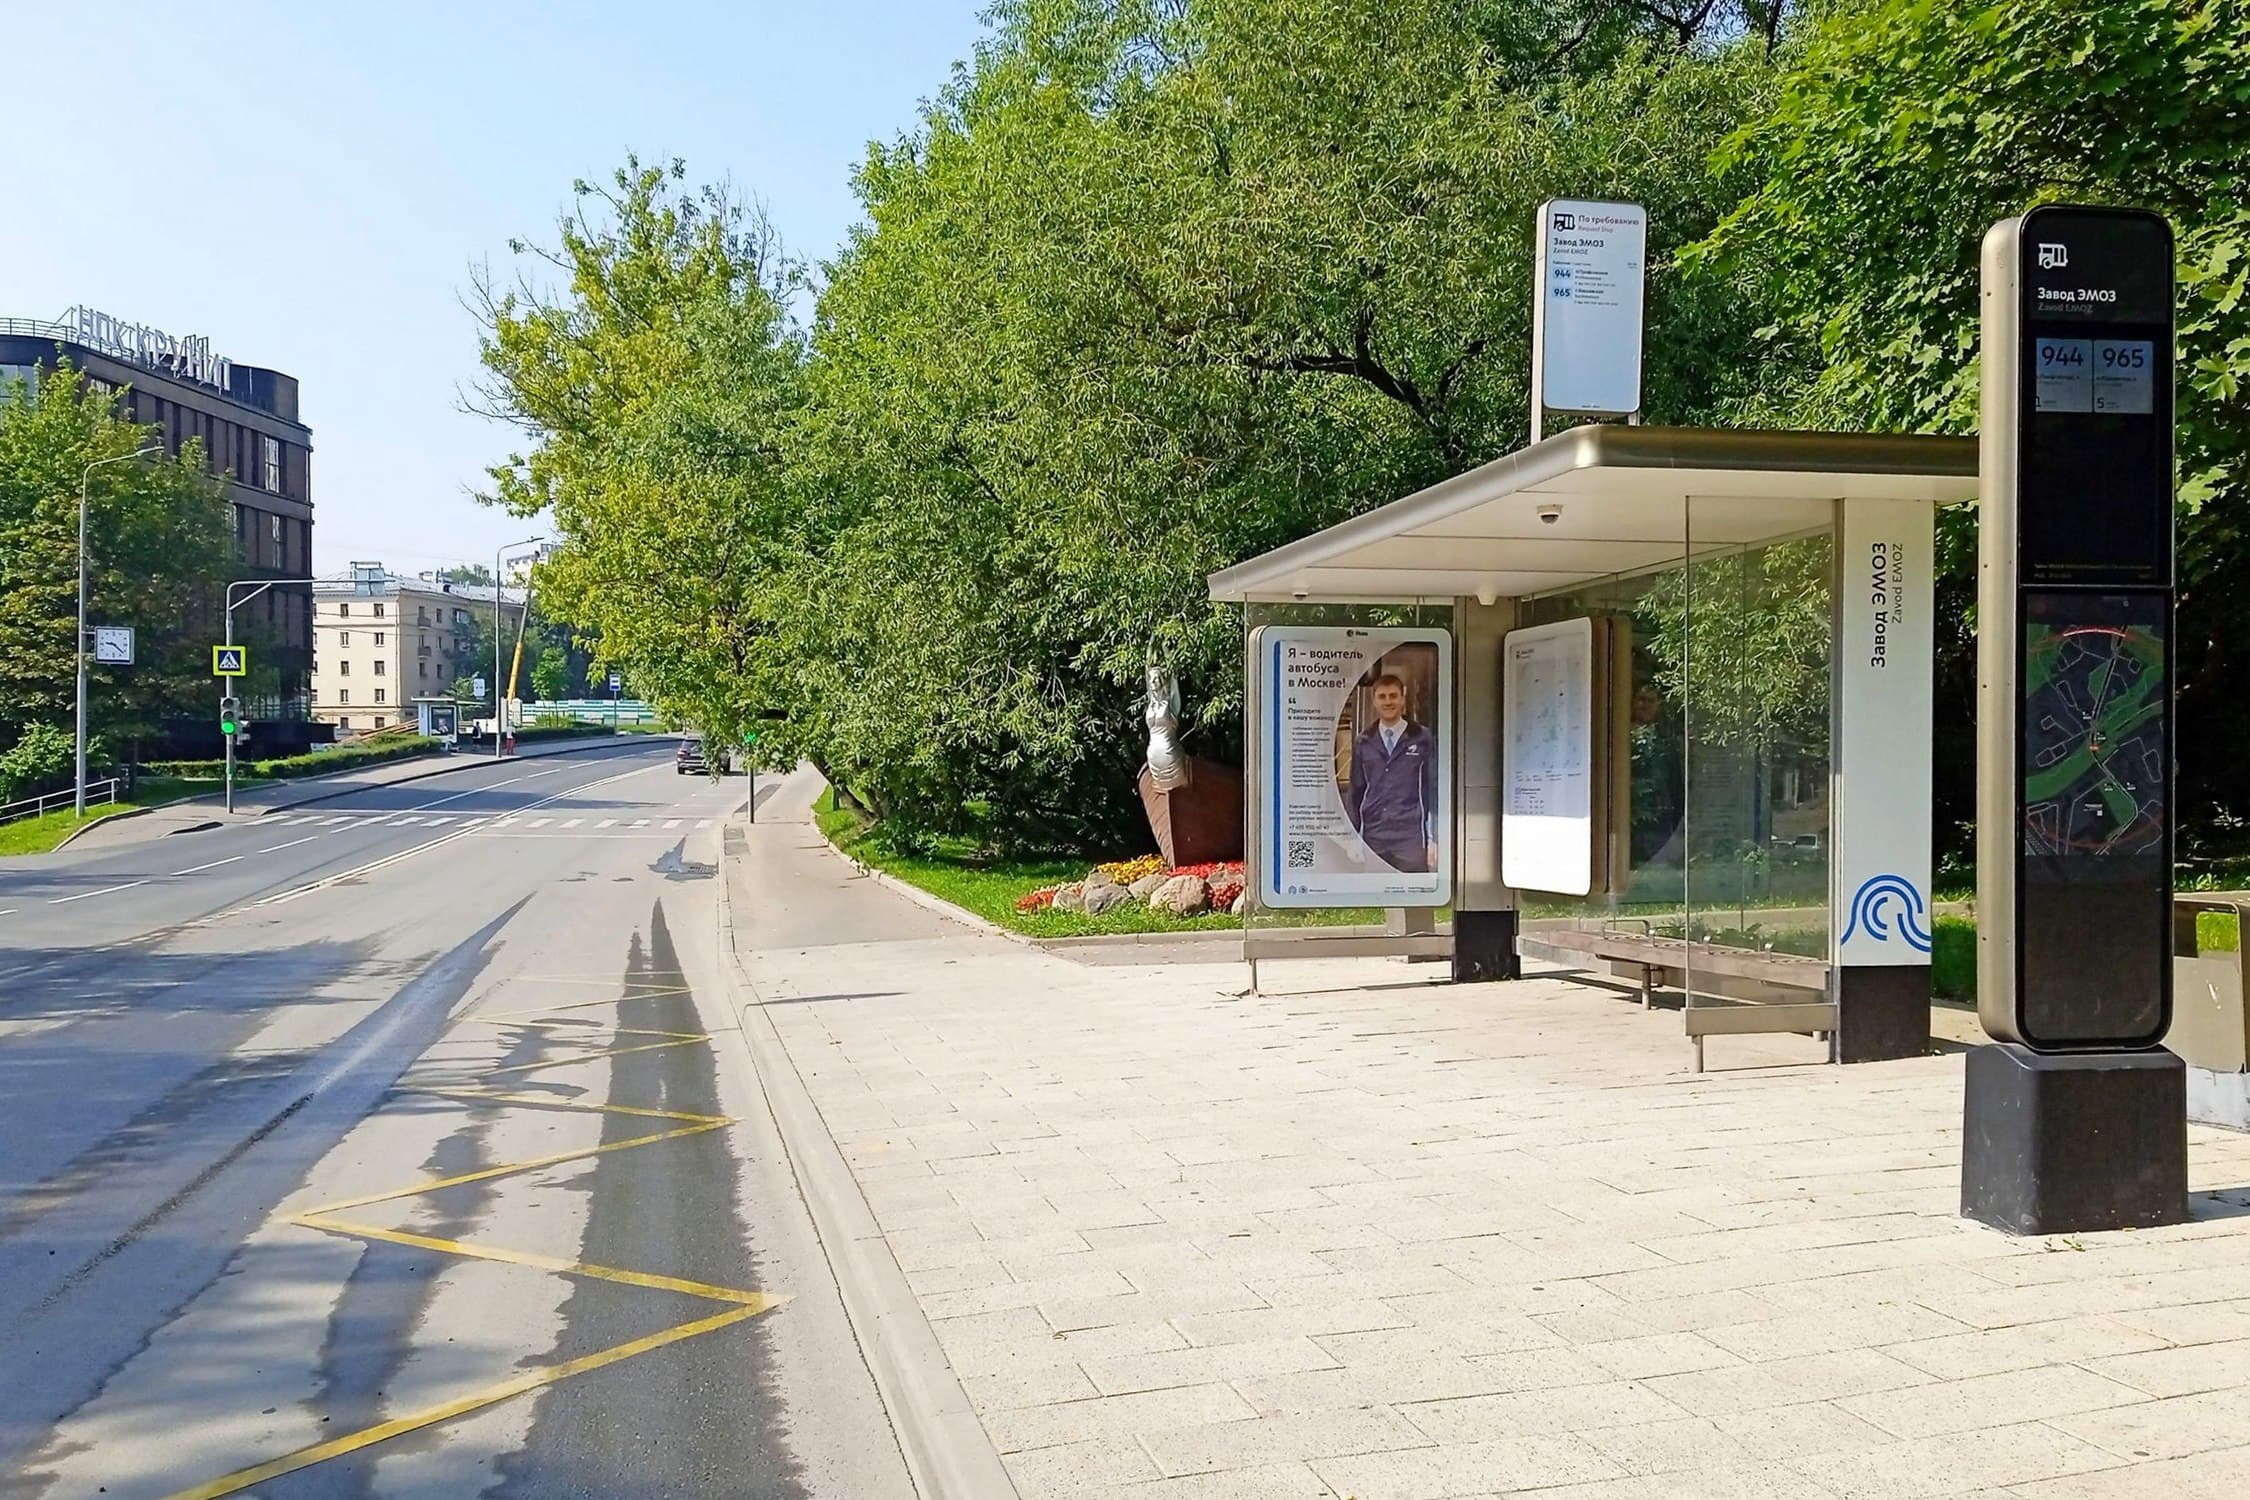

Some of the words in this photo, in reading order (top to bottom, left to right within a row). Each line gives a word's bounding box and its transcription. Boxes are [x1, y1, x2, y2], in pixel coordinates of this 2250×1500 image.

[1578, 215, 1590, 223] По
[1591, 215, 1639, 225] требованию
[1553, 237, 1577, 247] Завод
[1579, 238, 1604, 248] ЭМОЗ
[1554, 269, 1571, 278] 944
[1553, 288, 1571, 297] 965
[2037, 287, 2075, 302] Завод
[2077, 288, 2117, 302] ЭМОЗ
[2041, 346, 2084, 367] 944
[2102, 348, 2145, 368] 965
[2097, 398, 2104, 409] 5
[1892, 543, 1903, 583] EMOZ
[1871, 542, 1886, 605] ЭМОЗ
[1892, 586, 1902, 624] Zavod
[1871, 611, 1888, 668] Завод
[1288, 647, 1296, 658] Я
[1309, 649, 1364, 660] водитель
[1287, 662, 1339, 675] автобуса
[1288, 679, 1295, 688] в
[1297, 677, 1346, 688] Москве!
